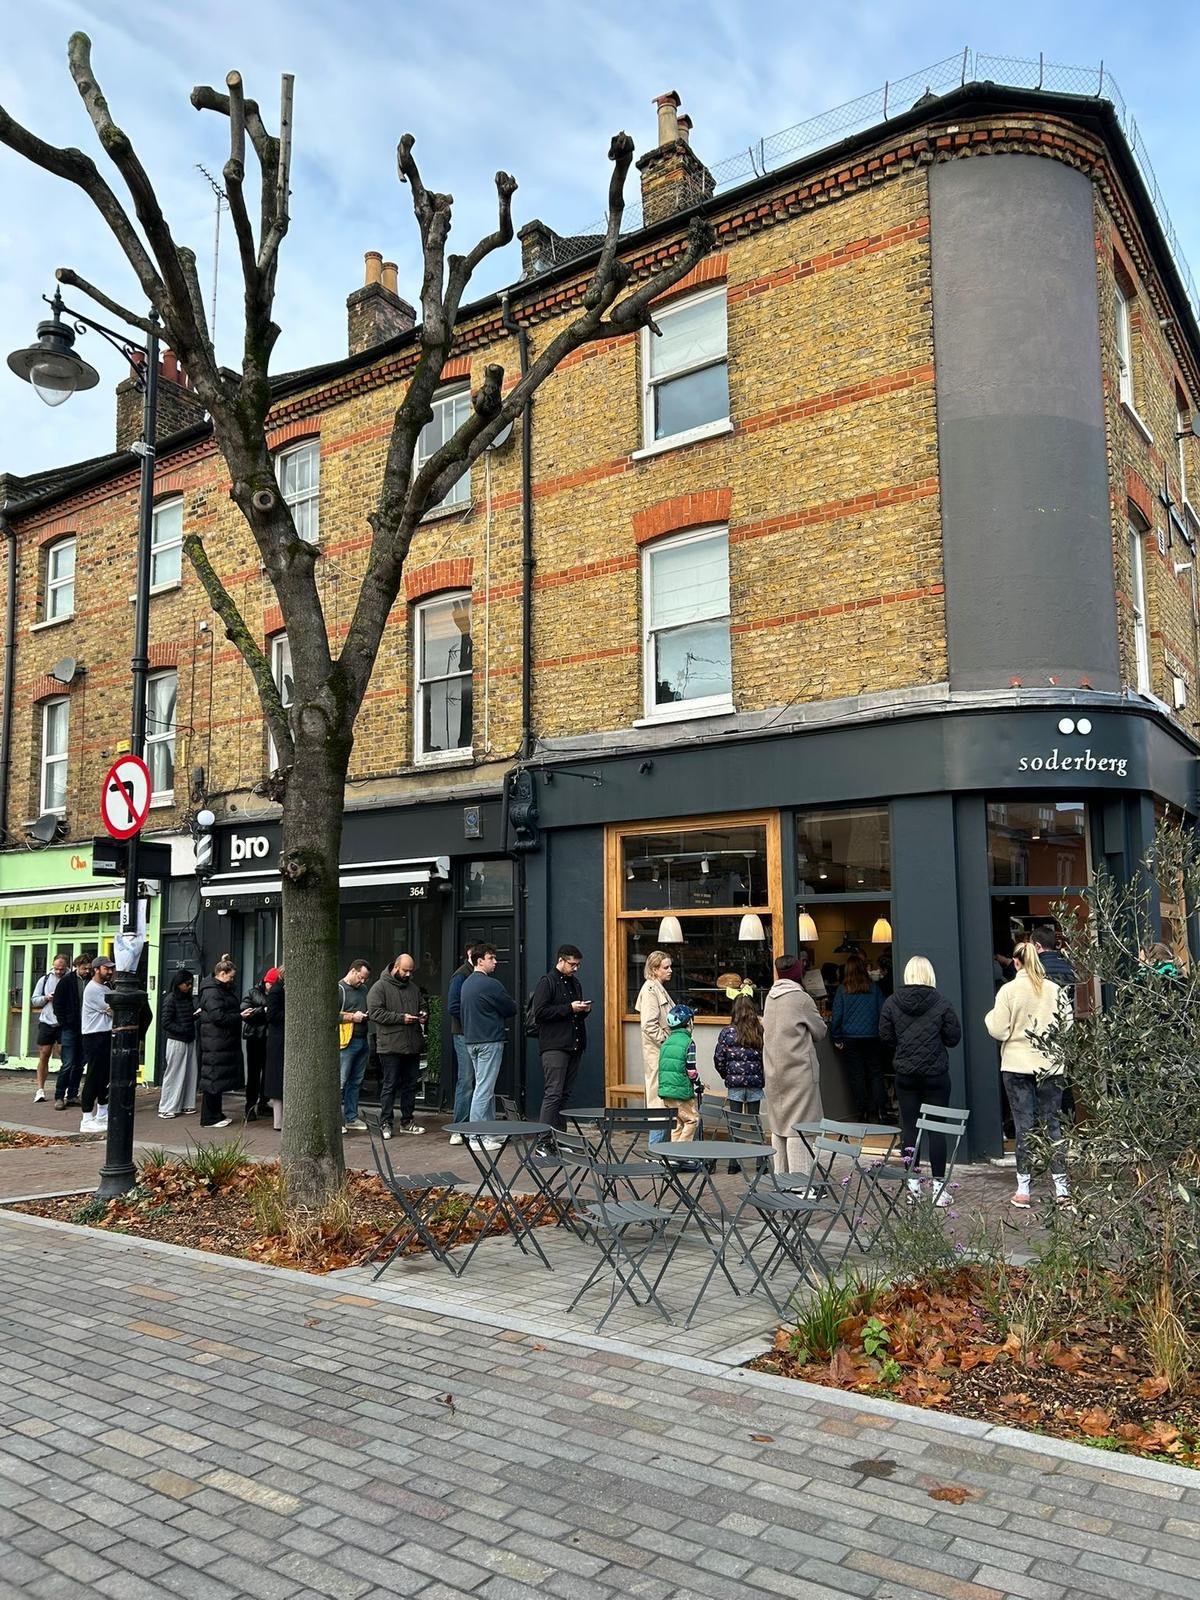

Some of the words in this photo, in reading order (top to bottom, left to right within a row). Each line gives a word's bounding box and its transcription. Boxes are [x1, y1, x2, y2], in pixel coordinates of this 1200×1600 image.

[1018, 748, 1128, 777] soderberg
[230, 834, 270, 861] bro
[70, 855, 87, 870] Cha
[409, 886, 425, 897] 364
[64, 903, 81, 913] CHA
[83, 901, 104, 912] THAI
